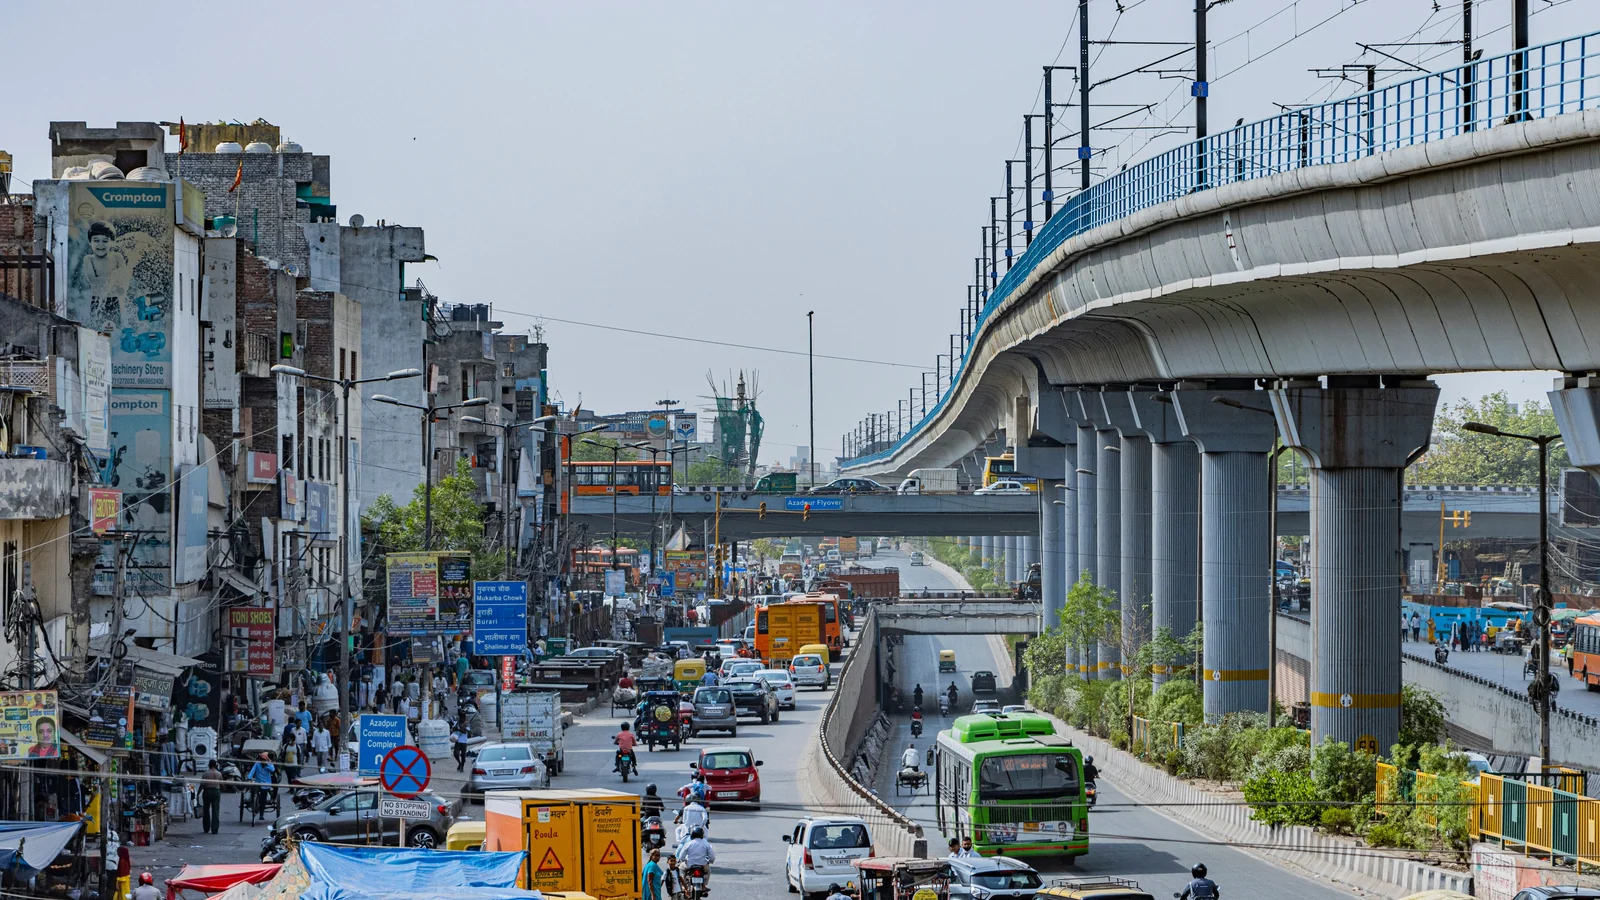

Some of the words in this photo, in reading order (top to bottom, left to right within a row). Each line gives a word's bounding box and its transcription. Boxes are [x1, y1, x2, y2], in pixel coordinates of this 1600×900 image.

[102, 192, 161, 204] Crompton
[145, 363, 164, 375] Store
[111, 400, 158, 410] ompton
[232, 611, 248, 624] TONI
[250, 611, 272, 625] SHOES
[511, 643, 525, 651] Bagh
[369, 719, 397, 728] Azadpur
[363, 729, 402, 738] Commercial
[367, 740, 397, 749] Complex
[395, 802, 427, 811] STOPPING
[395, 809, 427, 817] STANDING
